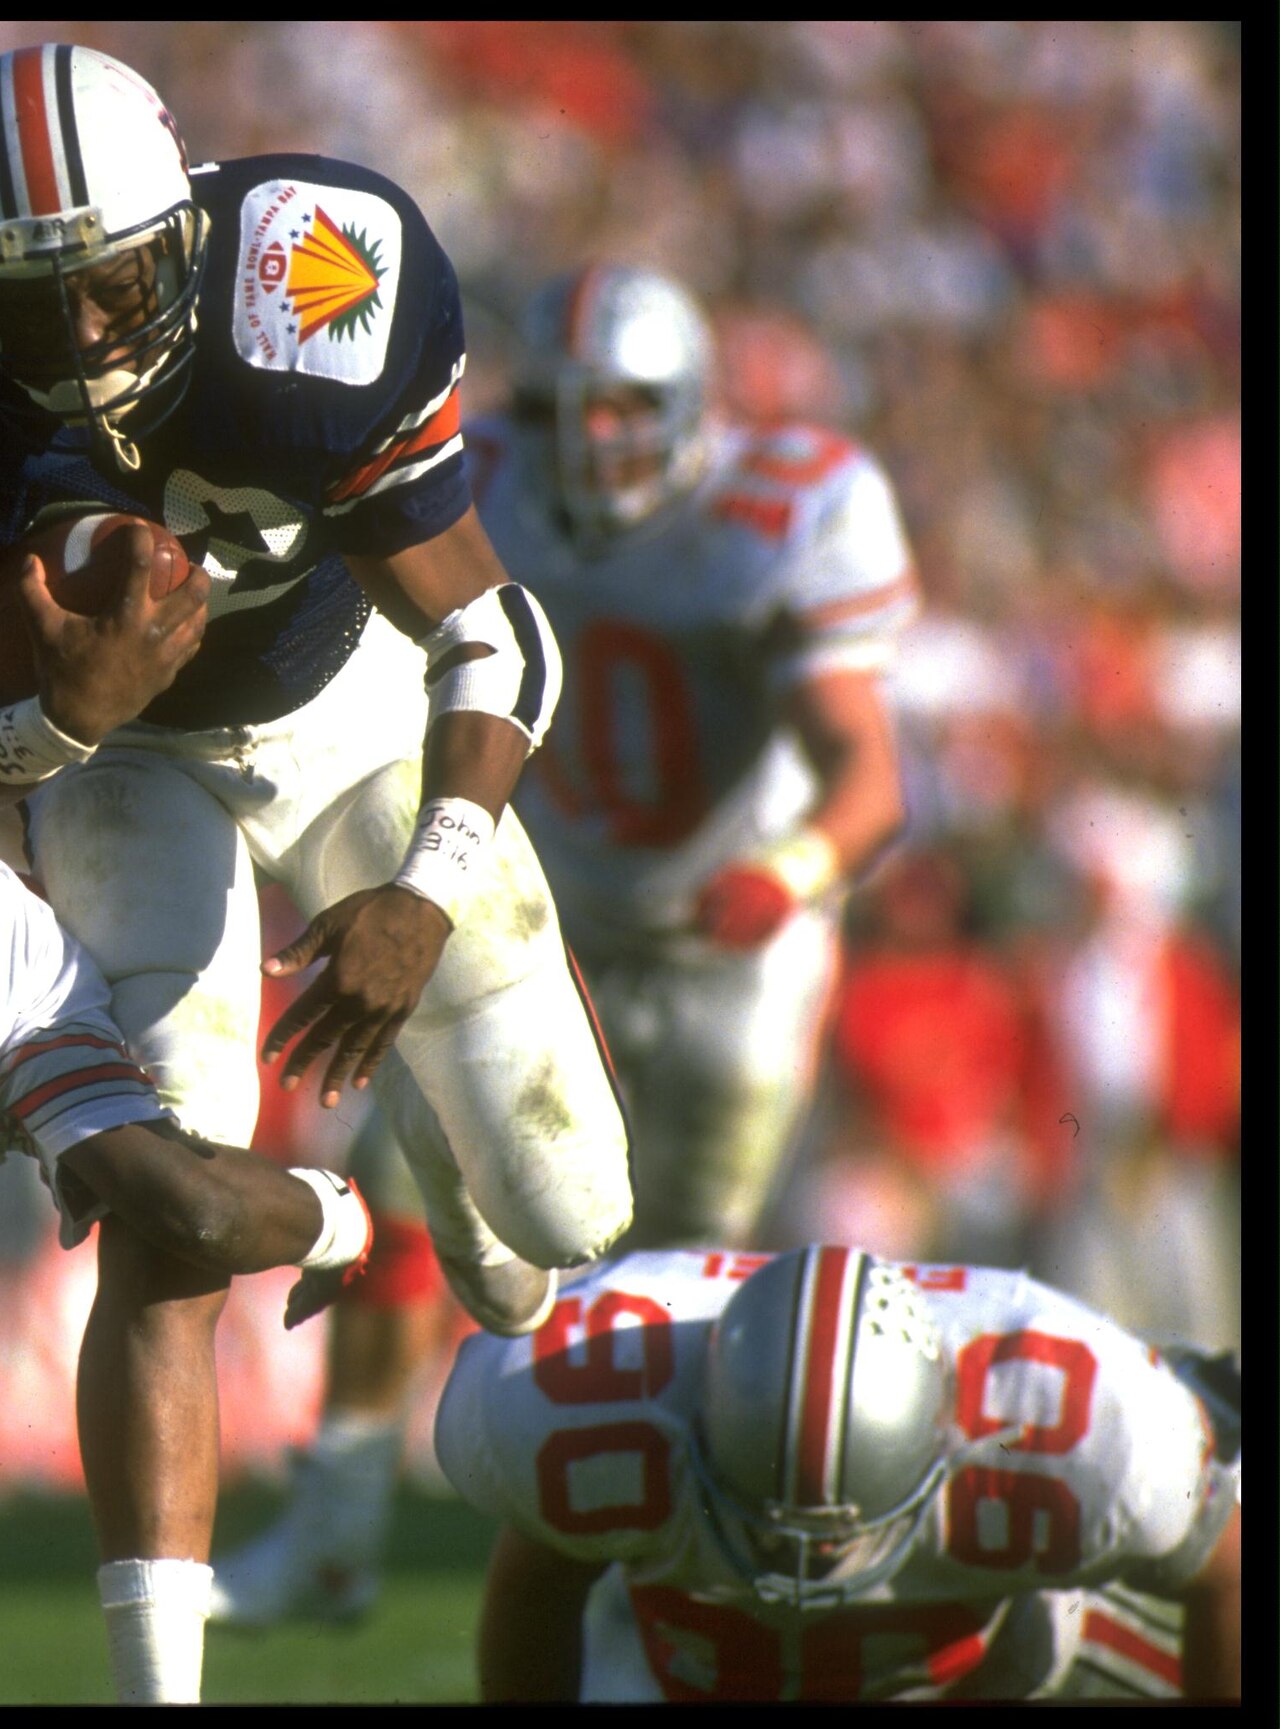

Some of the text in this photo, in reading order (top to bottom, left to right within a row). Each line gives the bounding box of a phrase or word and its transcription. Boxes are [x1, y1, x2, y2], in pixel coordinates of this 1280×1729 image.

[277, 185, 297, 204] BAY
[245, 277, 256, 309] FAME
[248, 314, 261, 328] OF
[256, 331, 277, 360] HALL
[420, 806, 480, 846] John
[533, 1289, 675, 1536] 90
[948, 1329, 1098, 1576] 90
